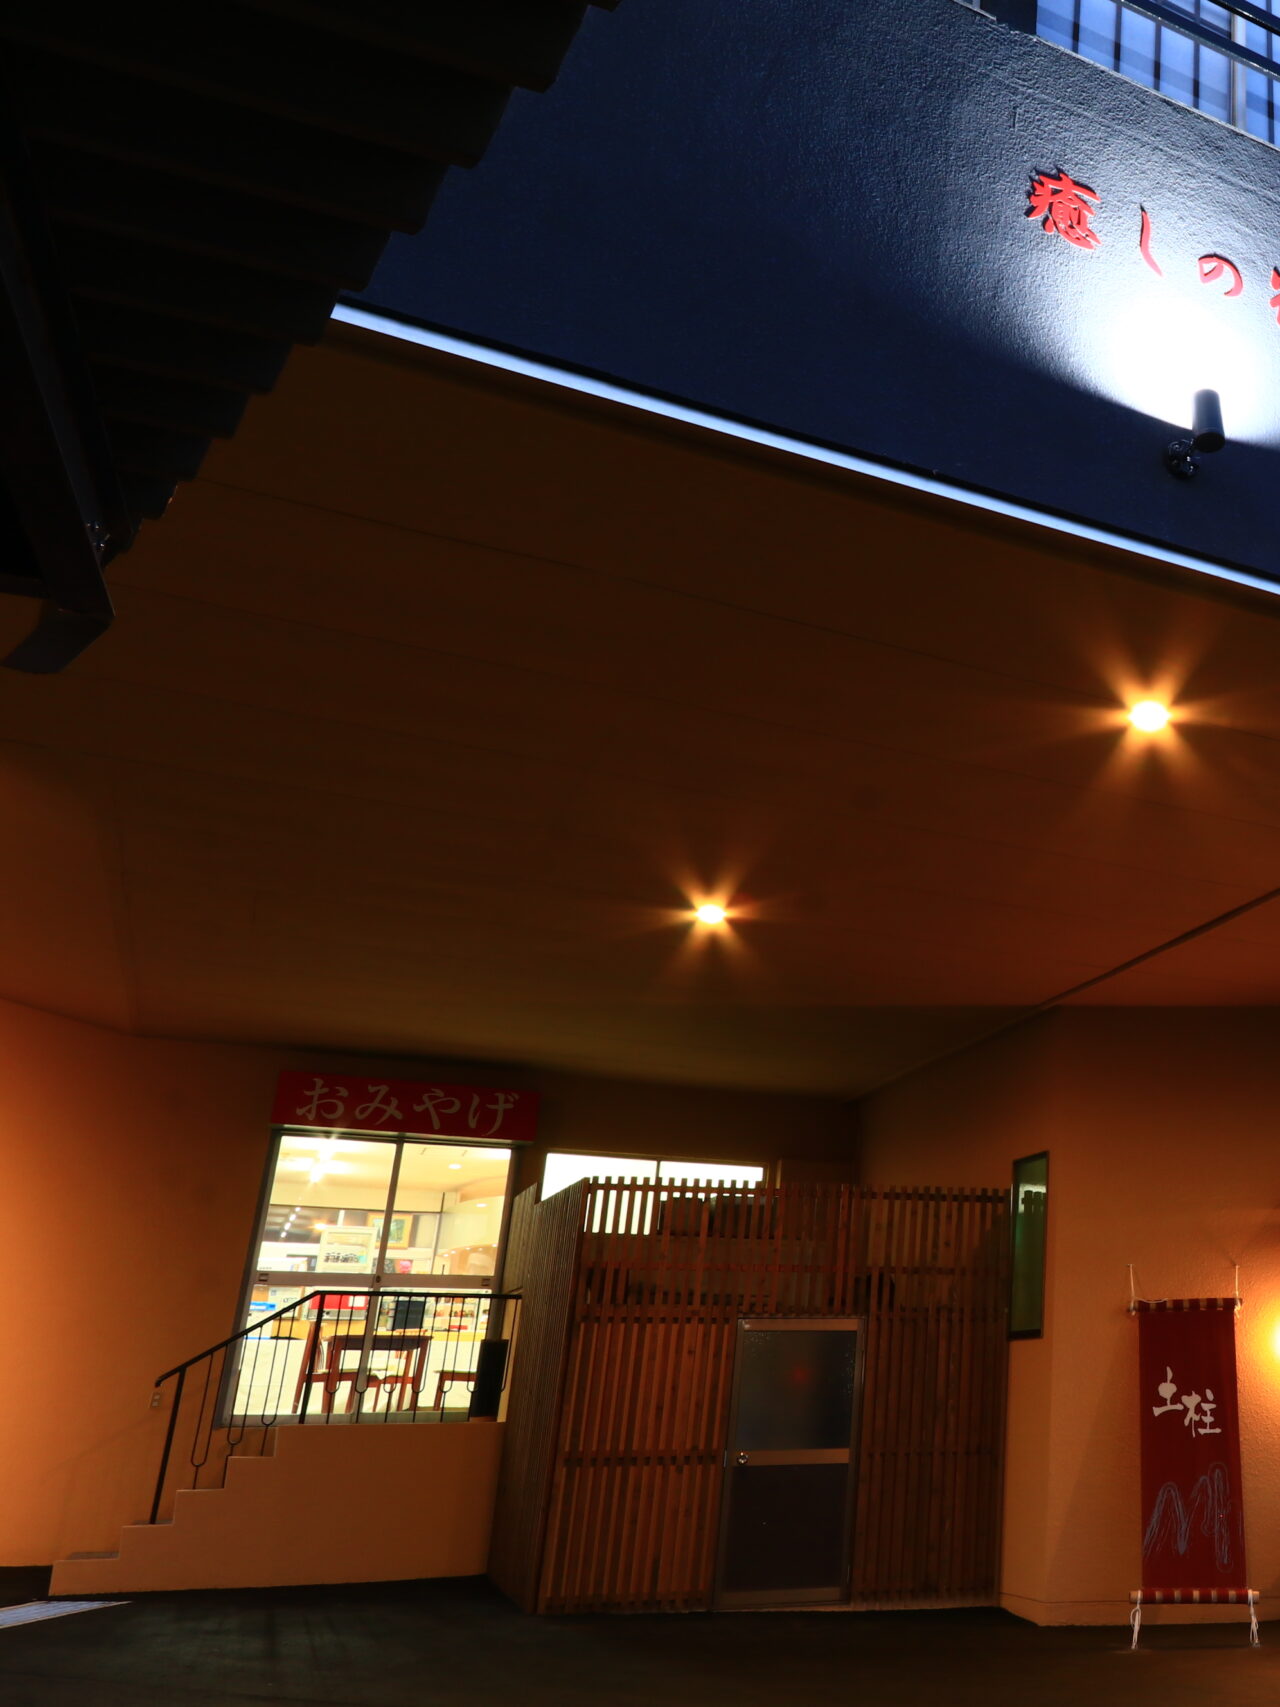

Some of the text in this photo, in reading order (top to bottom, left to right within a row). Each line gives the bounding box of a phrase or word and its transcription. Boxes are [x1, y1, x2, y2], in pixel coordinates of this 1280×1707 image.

[295, 1077, 520, 1136] おみやげ
[1152, 1366, 1222, 1438] 土柱
